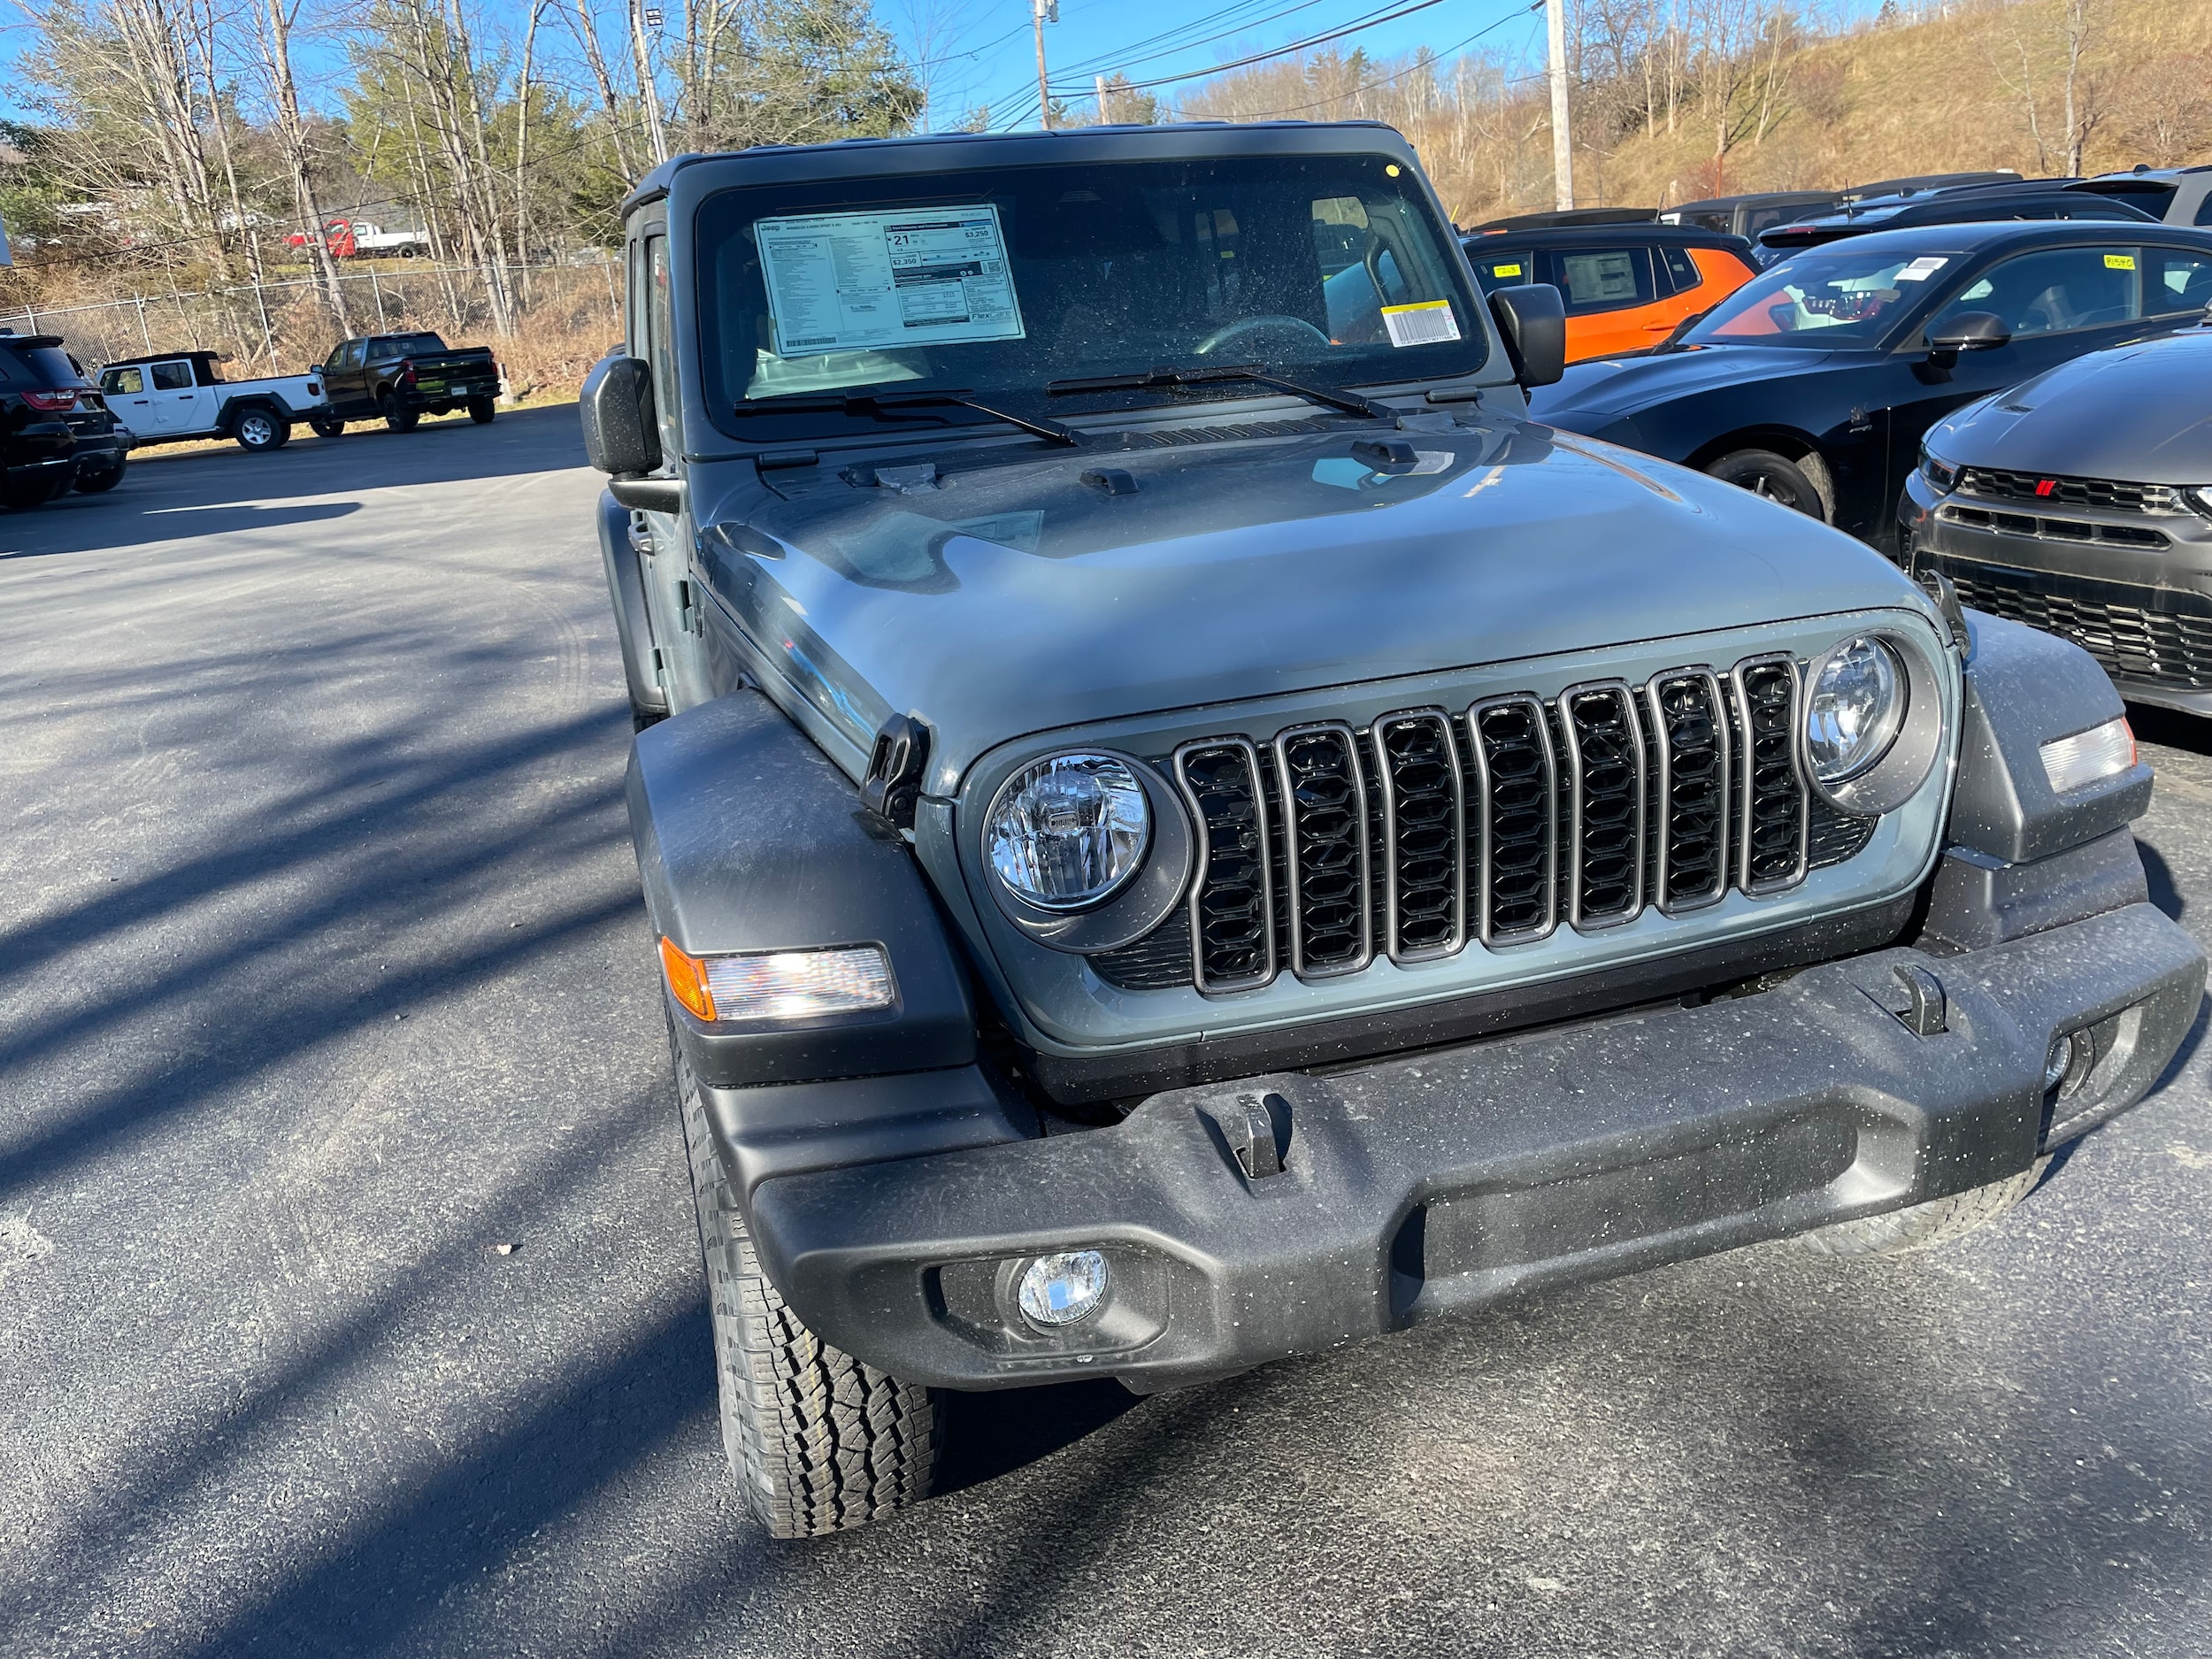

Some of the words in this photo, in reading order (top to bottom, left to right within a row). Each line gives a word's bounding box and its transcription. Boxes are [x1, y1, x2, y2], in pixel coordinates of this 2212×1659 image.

[965, 230, 989, 239] $3,250
[894, 234, 910, 246] 21
[972, 310, 1011, 319] FlexCare
